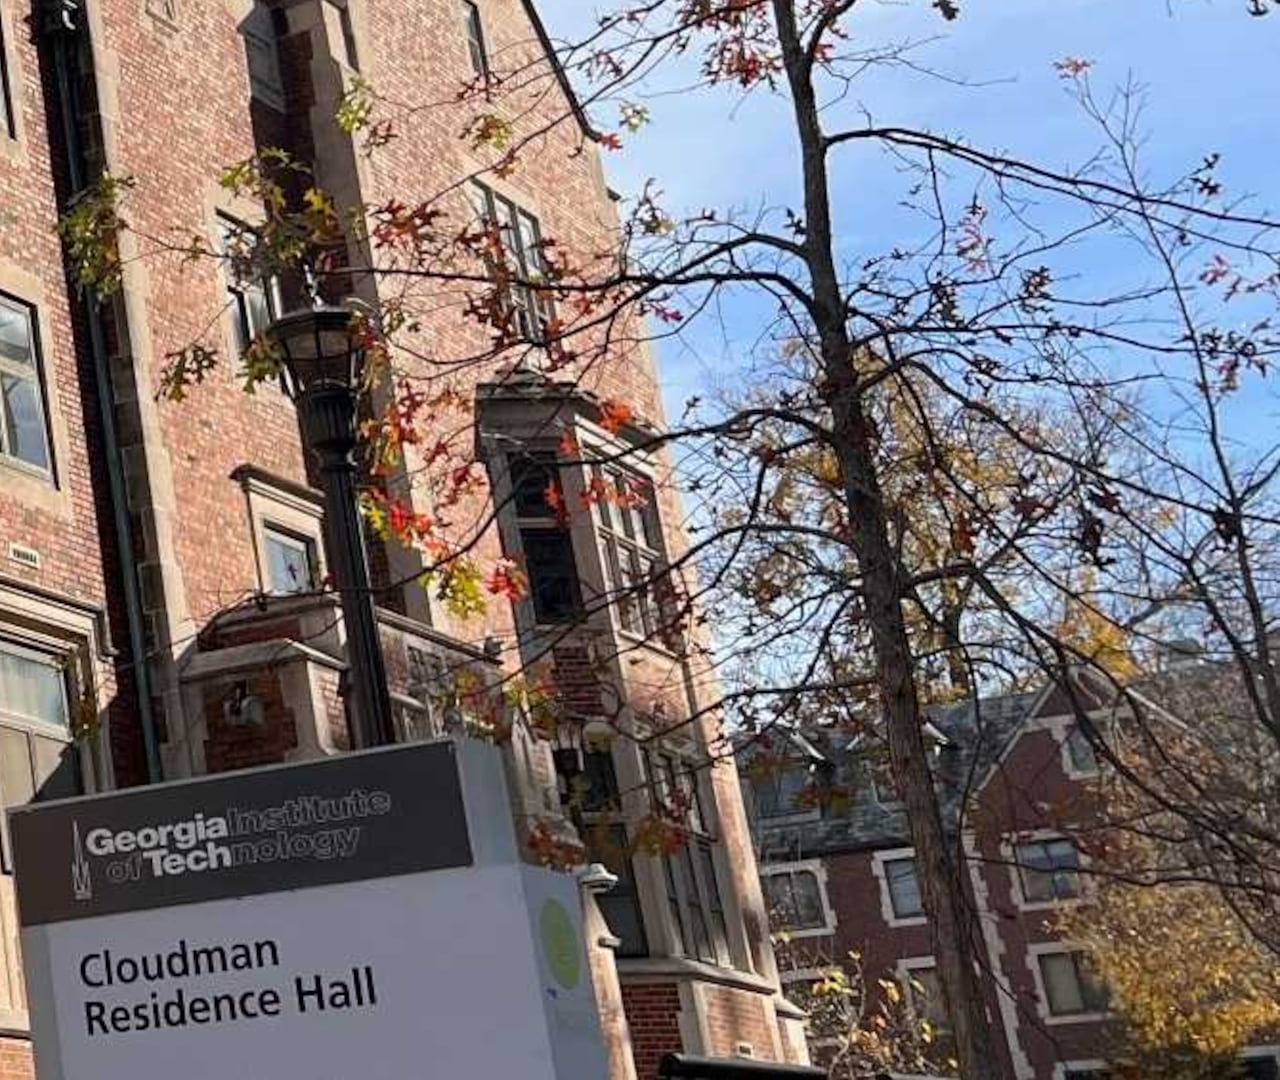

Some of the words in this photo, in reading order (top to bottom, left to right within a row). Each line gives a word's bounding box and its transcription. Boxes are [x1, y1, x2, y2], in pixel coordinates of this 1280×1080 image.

[86, 812, 228, 856] Georgia
[227, 790, 391, 837] Institute
[106, 859, 141, 883] of
[142, 825, 361, 878] Technology
[79, 939, 280, 988] Cloudman
[84, 987, 282, 1036] Residence
[295, 966, 378, 1013] Hall
